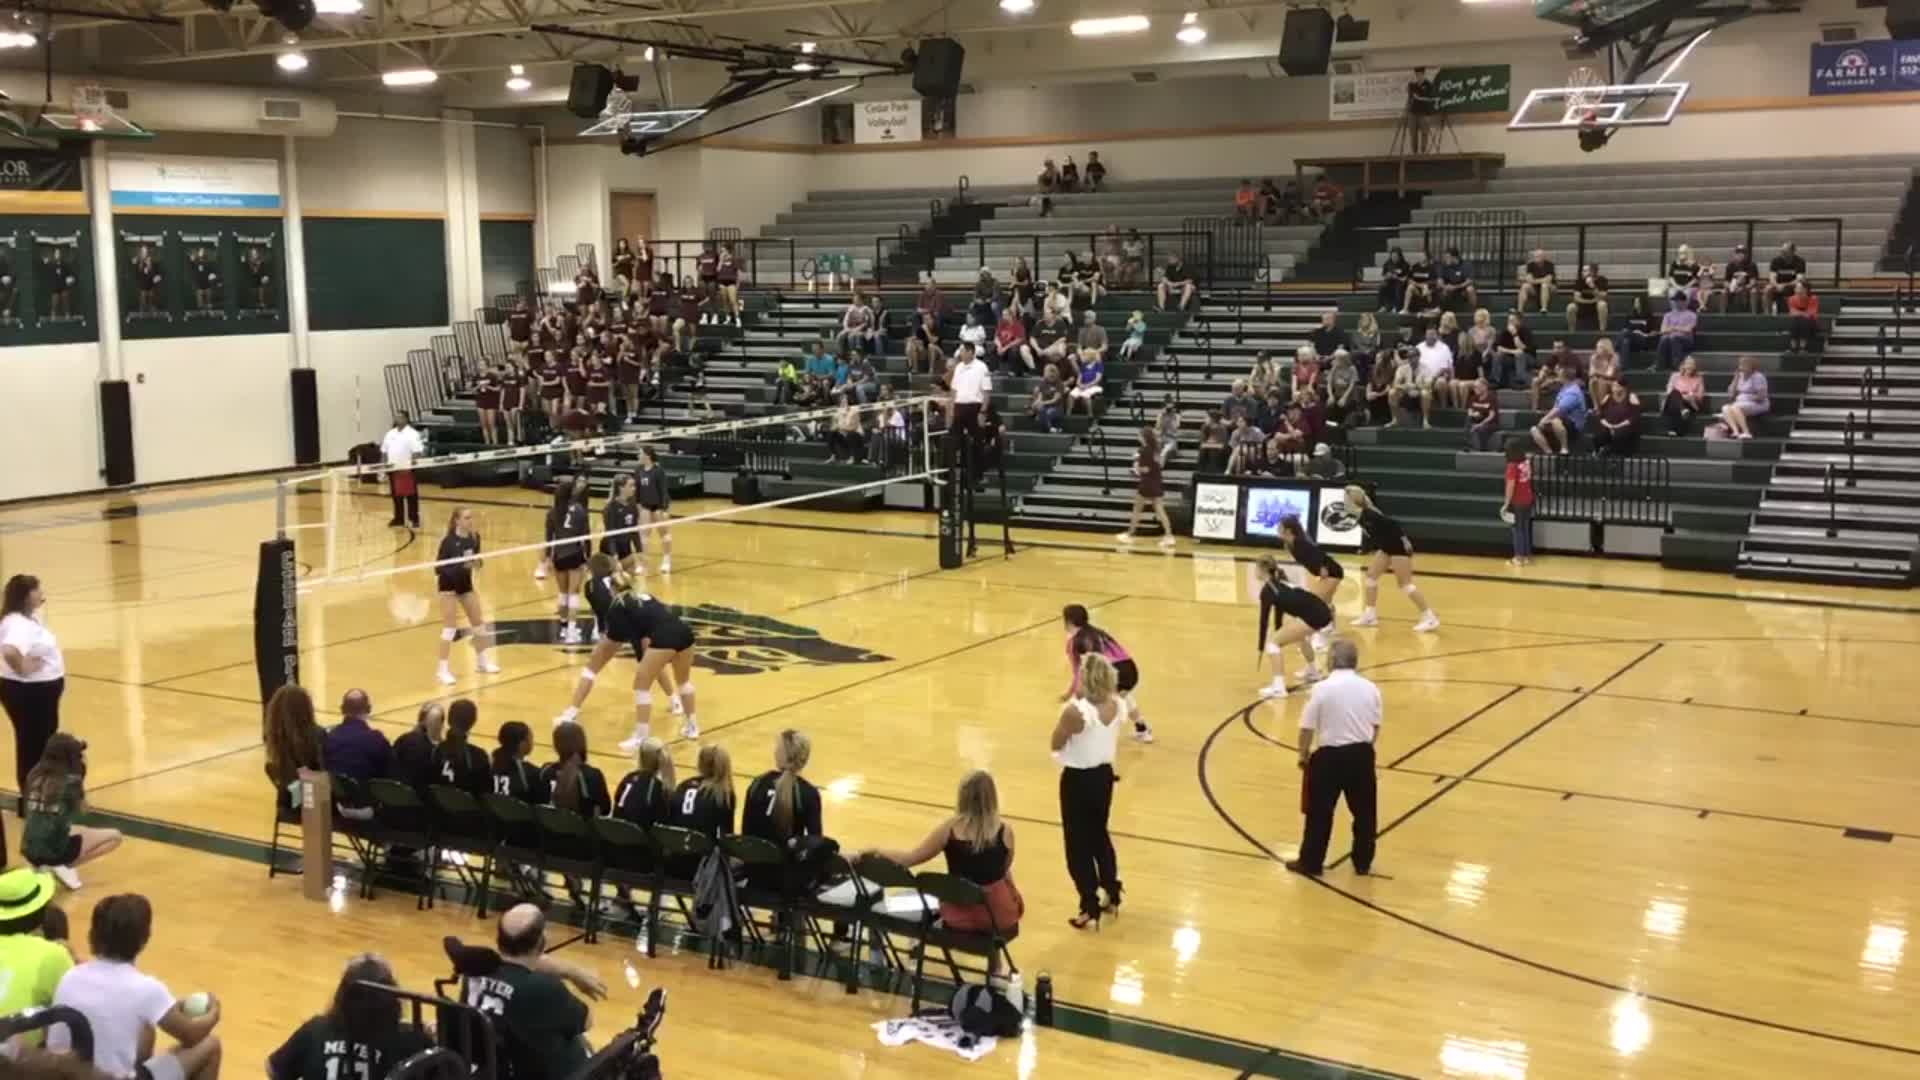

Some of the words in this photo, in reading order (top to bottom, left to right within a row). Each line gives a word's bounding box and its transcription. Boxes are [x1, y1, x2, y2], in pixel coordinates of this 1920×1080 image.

[1816, 66, 1887, 78] FARMERS
[864, 103, 888, 114] Cedar
[891, 101, 909, 112] Park
[867, 116, 906, 128] Volleyball
[442, 760, 454, 782] 4
[493, 775, 511, 796] 13
[682, 788, 698, 815] 8
[766, 789, 776, 817] 7
